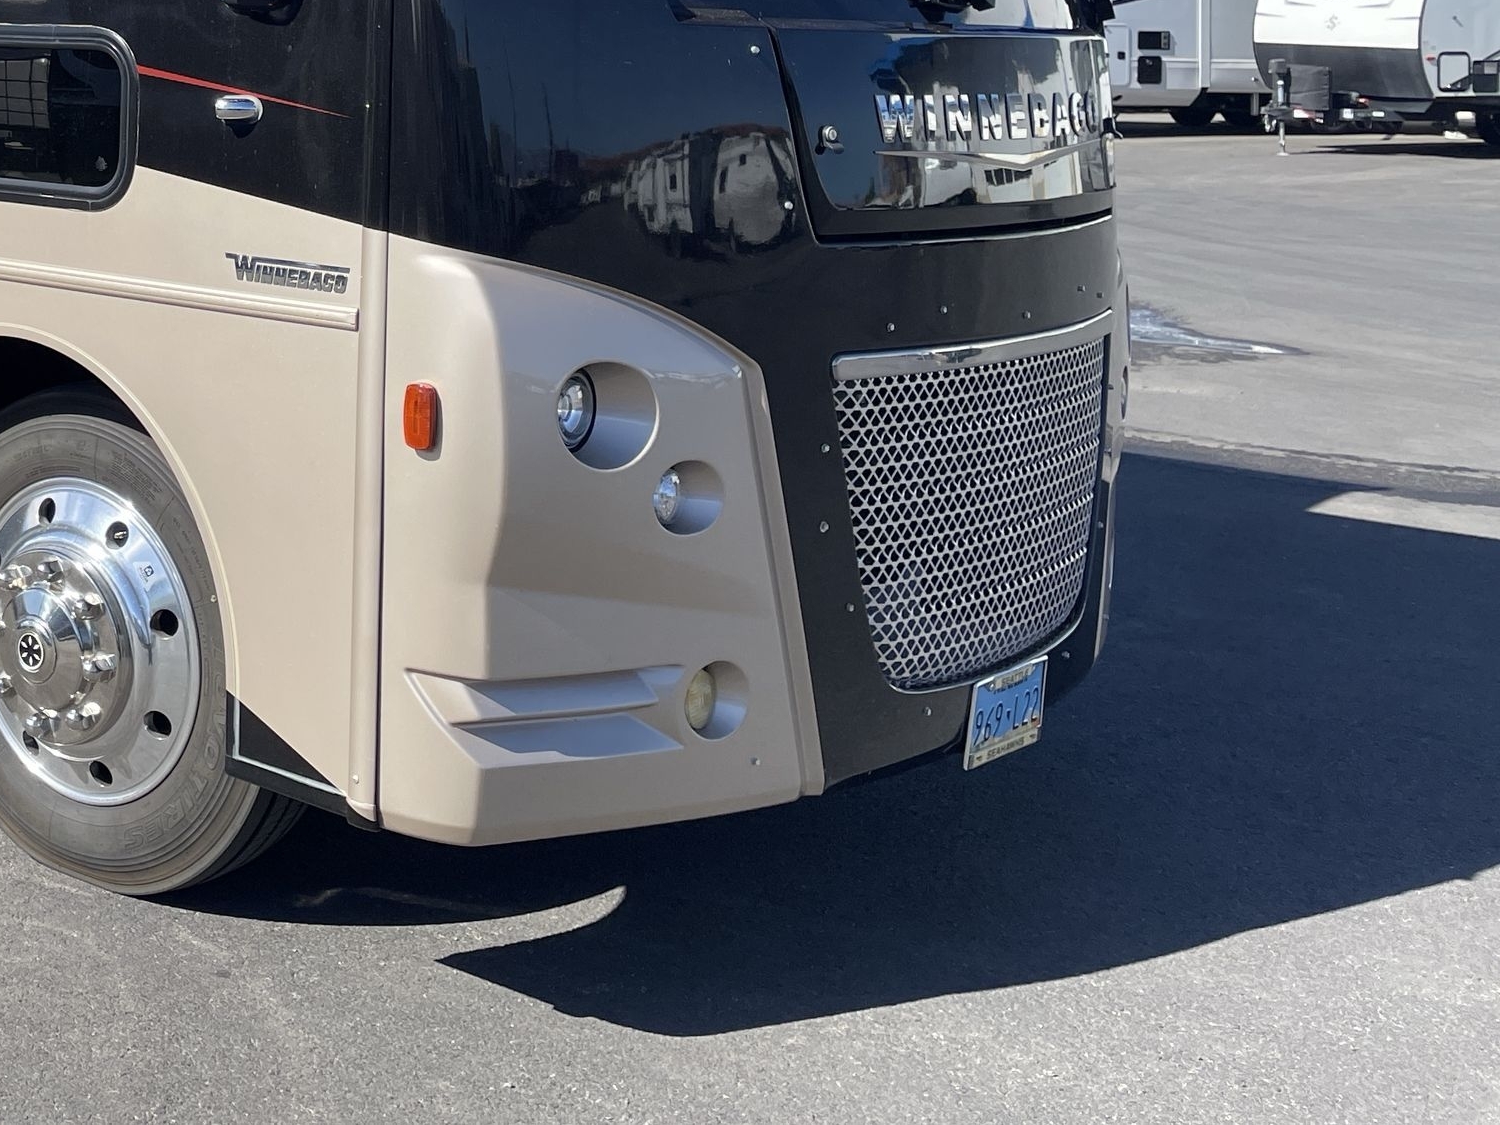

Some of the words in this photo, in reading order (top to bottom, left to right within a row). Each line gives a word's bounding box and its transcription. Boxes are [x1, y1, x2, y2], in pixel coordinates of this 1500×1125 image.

[873, 91, 1098, 142] WINNEBAGO
[233, 254, 349, 294] WINNEBAGO
[124, 769, 209, 851] TIRES
